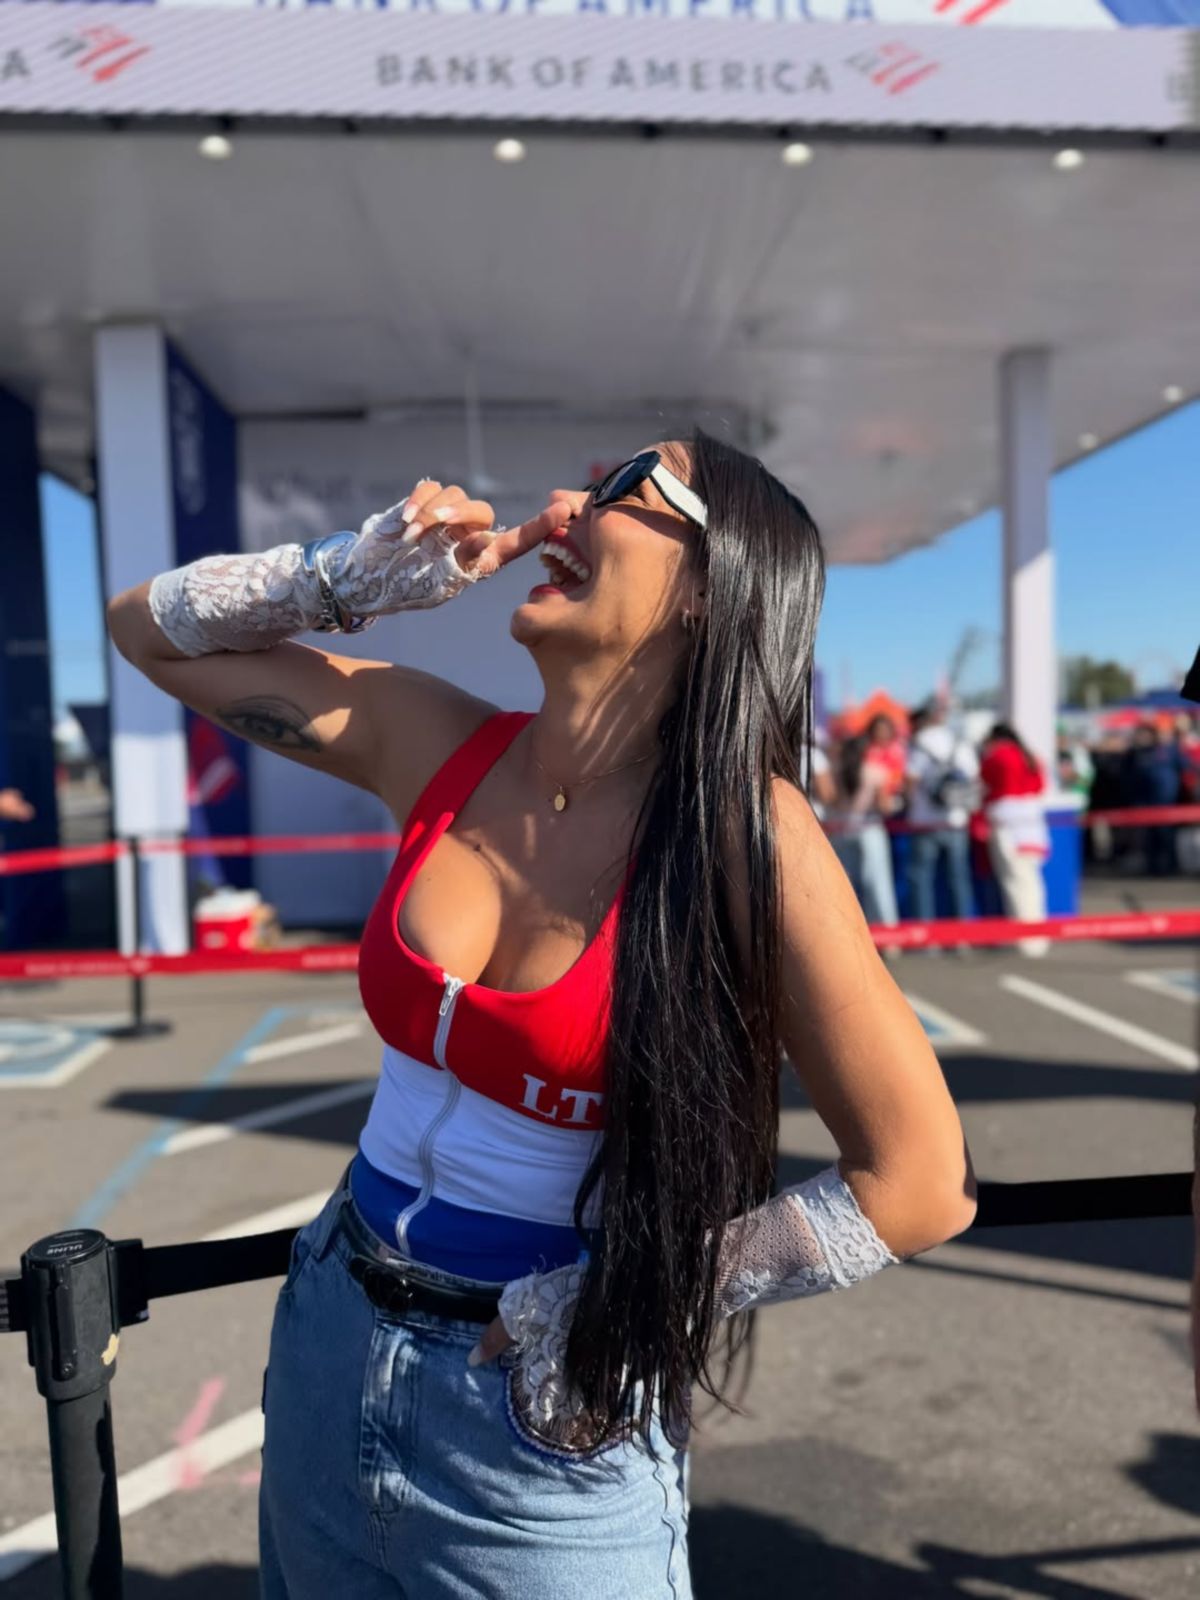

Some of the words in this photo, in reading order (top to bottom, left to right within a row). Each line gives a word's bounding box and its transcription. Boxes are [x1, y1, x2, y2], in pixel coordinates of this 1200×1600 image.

[376, 54, 514, 90] BANK
[531, 55, 592, 91] OF
[607, 56, 833, 95] AMERICA
[519, 1072, 603, 1124] LT
